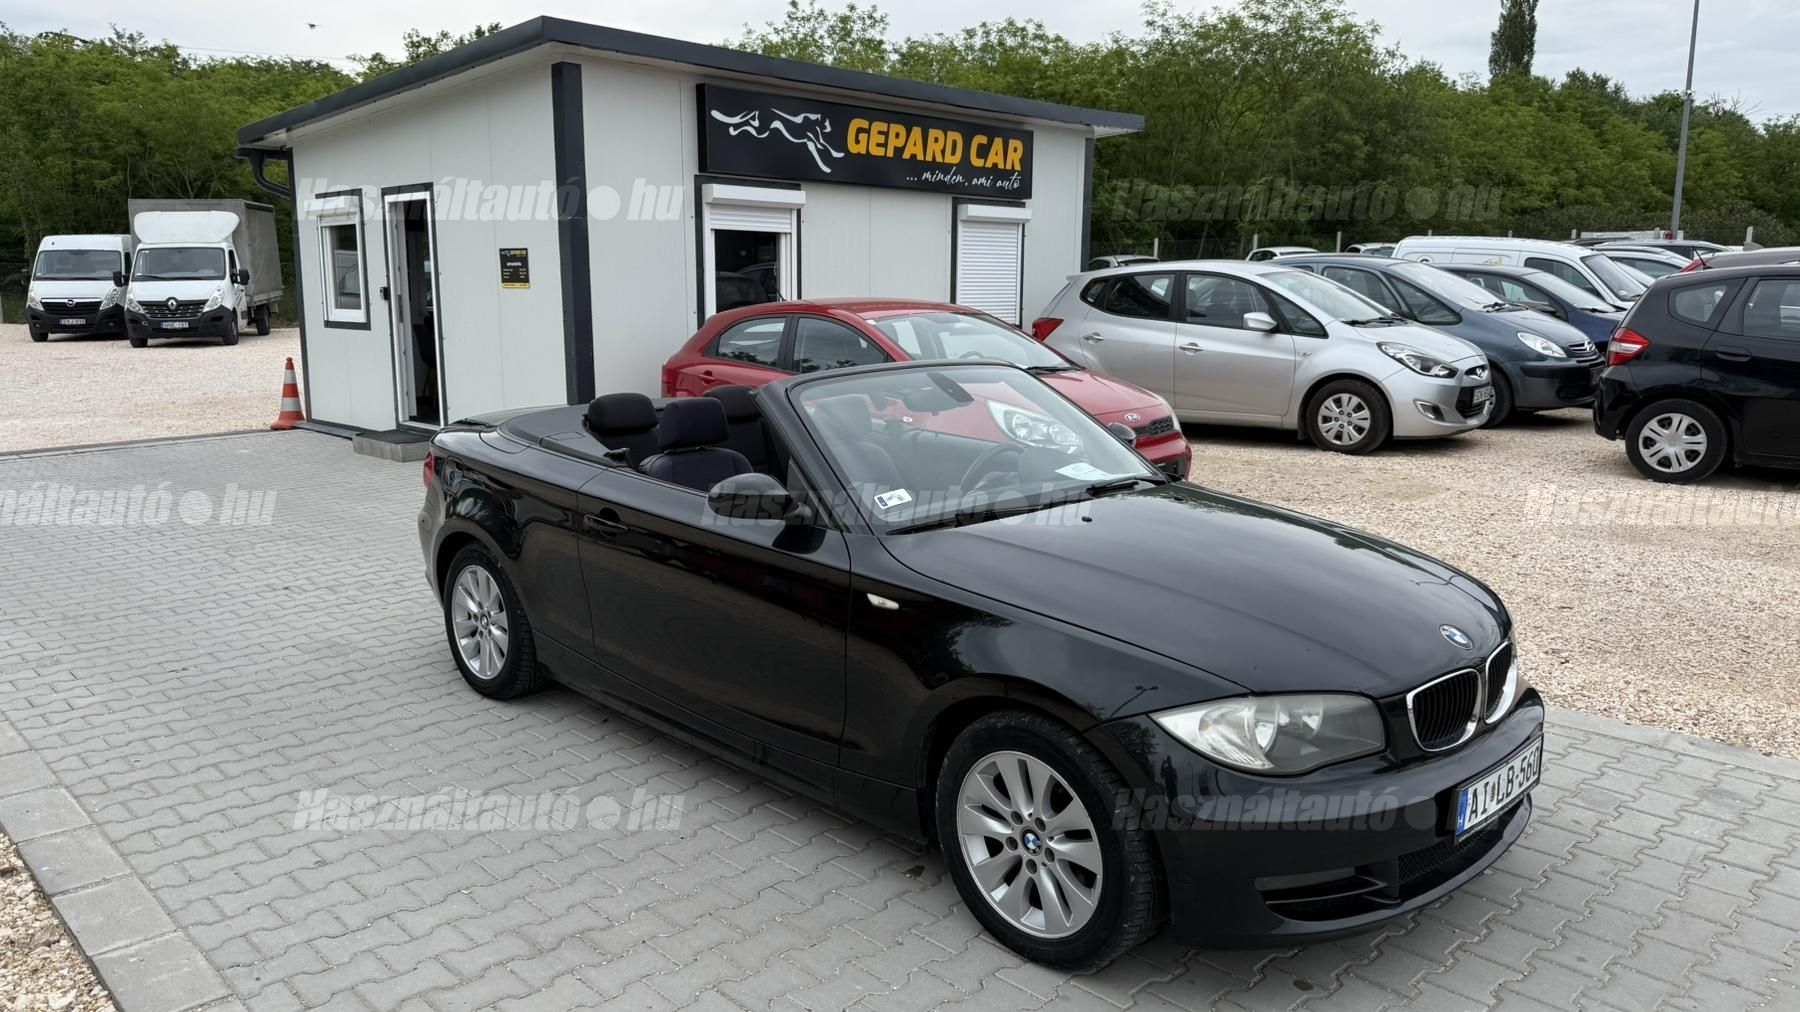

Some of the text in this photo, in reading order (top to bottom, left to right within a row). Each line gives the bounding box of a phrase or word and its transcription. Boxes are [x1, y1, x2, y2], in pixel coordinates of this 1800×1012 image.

[847, 118, 1024, 171] GEPARD CAR
[972, 175, 994, 188] ami
[1468, 780, 1490, 822] AI
